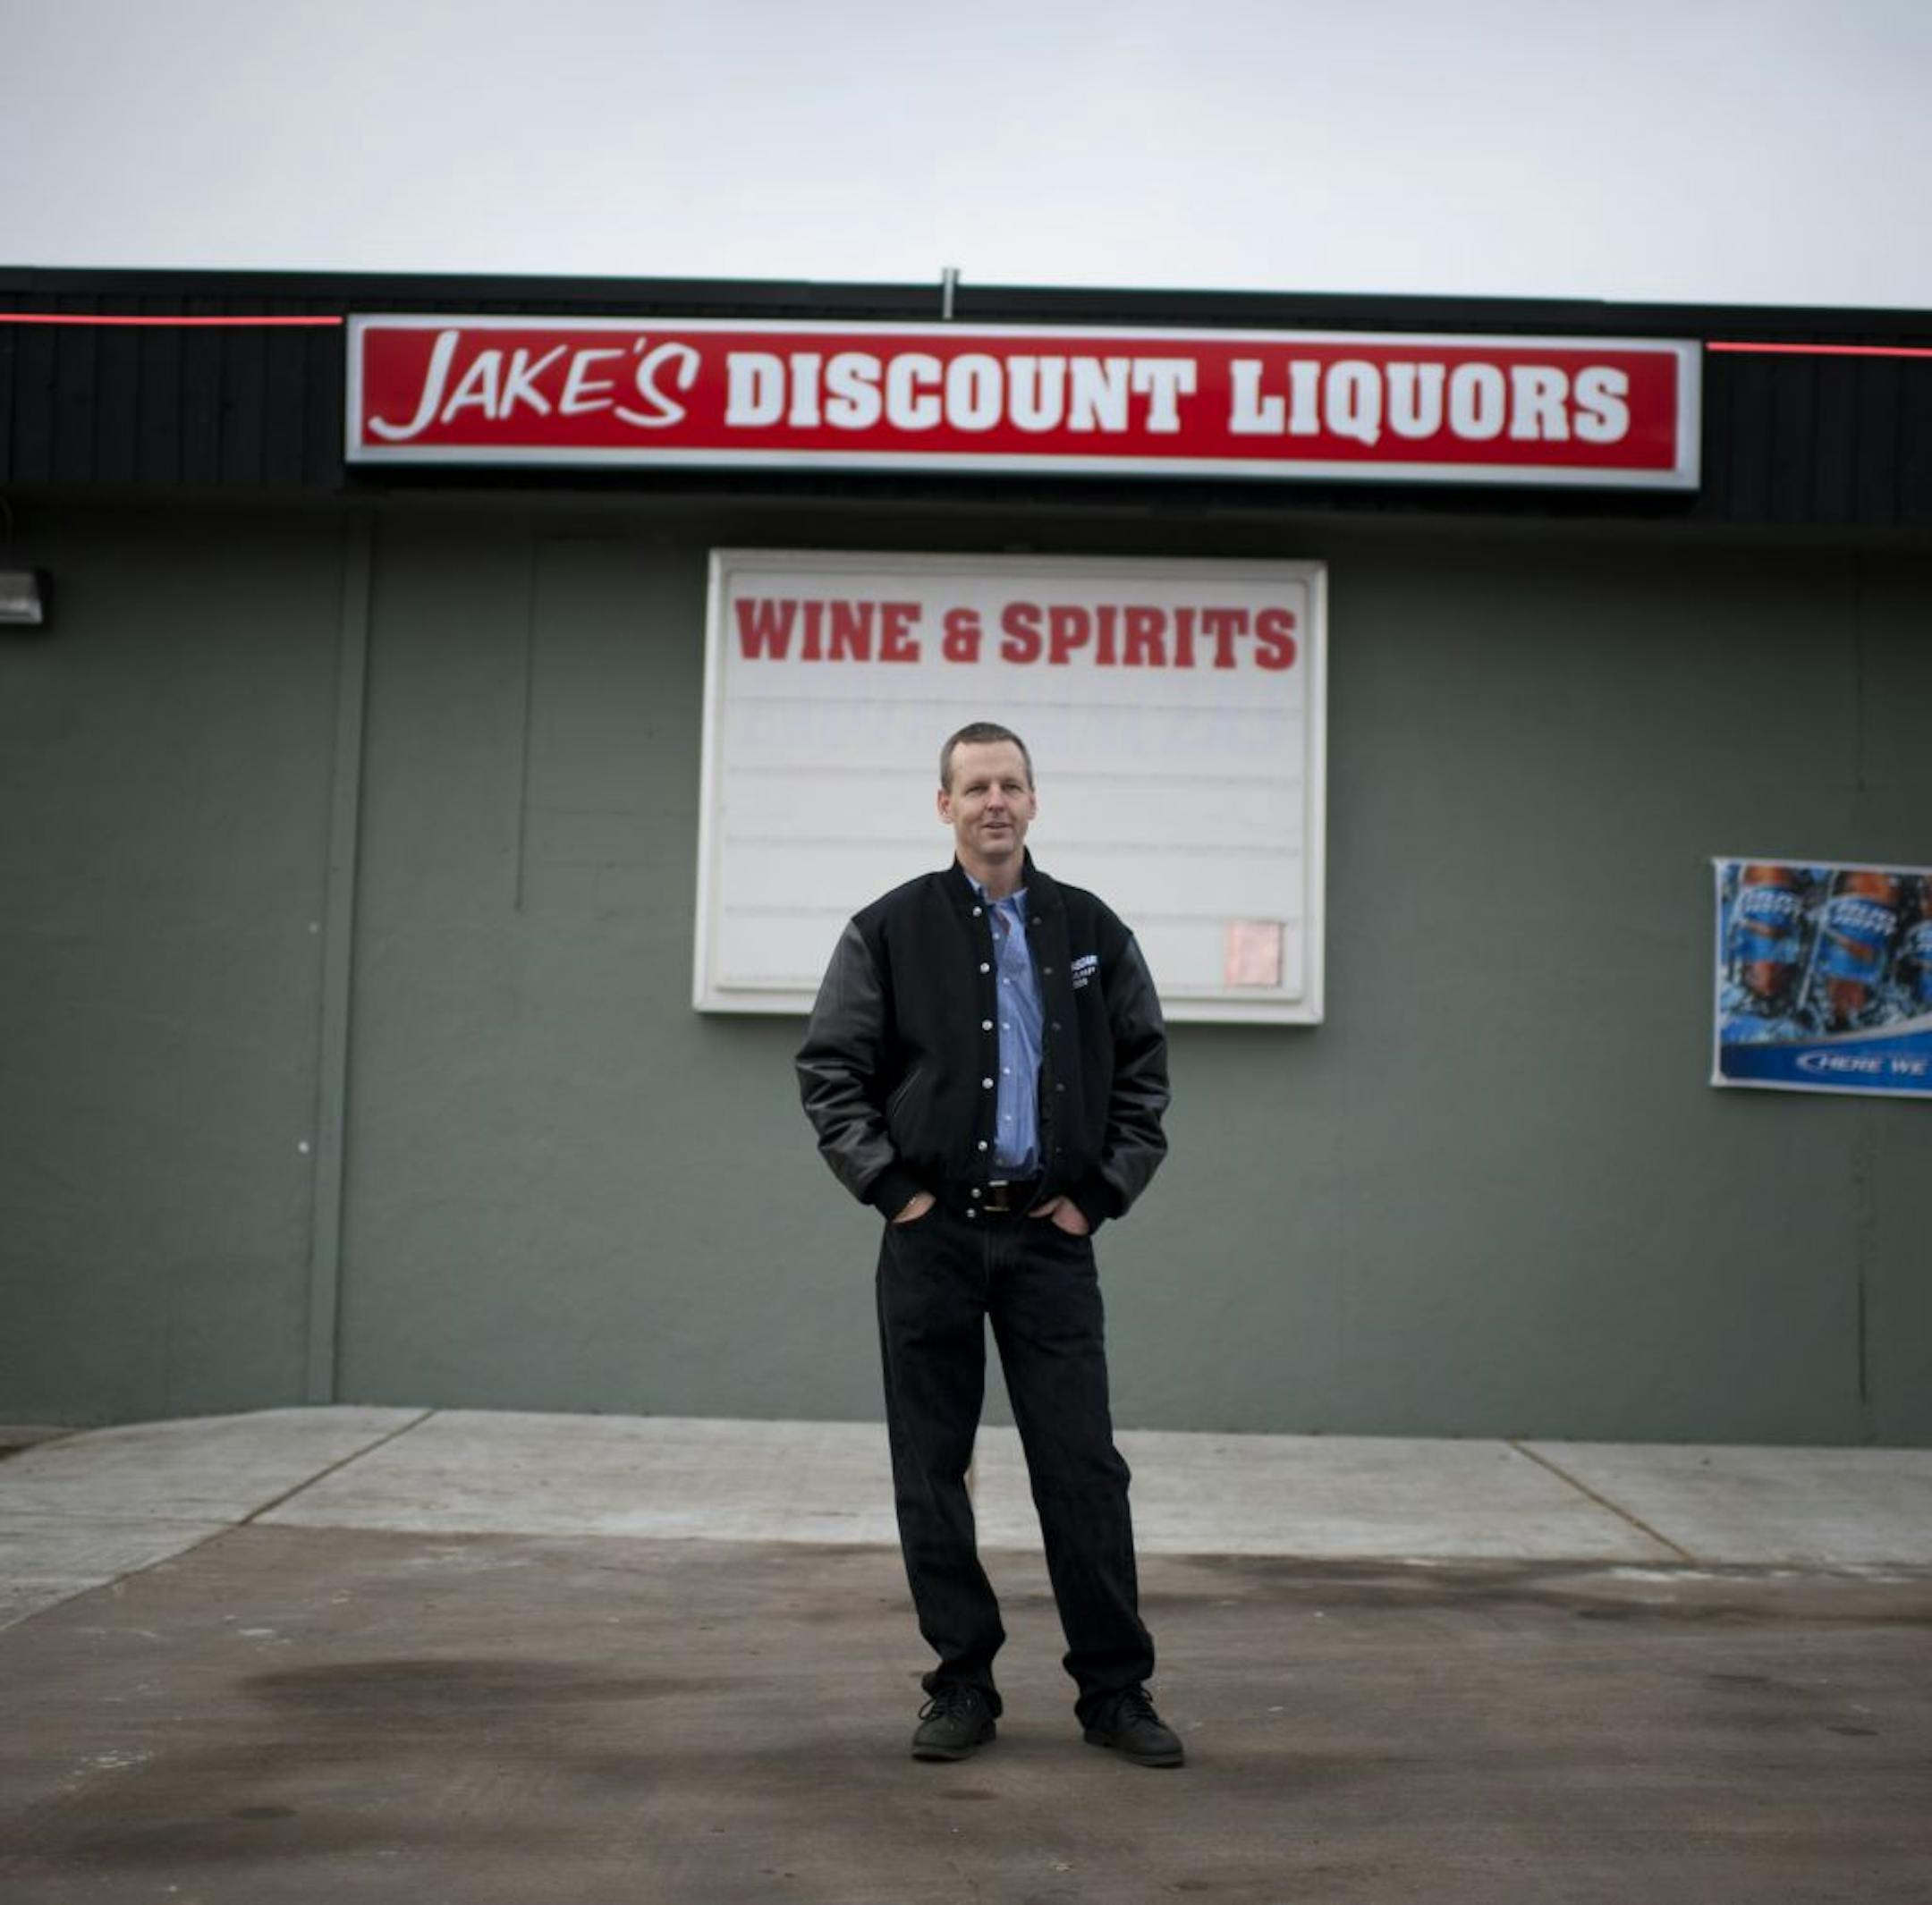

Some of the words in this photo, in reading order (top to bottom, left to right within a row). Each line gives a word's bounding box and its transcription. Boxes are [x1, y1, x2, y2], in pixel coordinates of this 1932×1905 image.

[369, 330, 700, 440] JAKE'S
[725, 352, 1197, 432] DISCOUNT
[1230, 360, 1628, 444] LIQUORS
[738, 602, 919, 662] WINE
[944, 611, 979, 662] &
[1003, 605, 1295, 670] SPIRITS
[1891, 1058, 1927, 1074] WE
